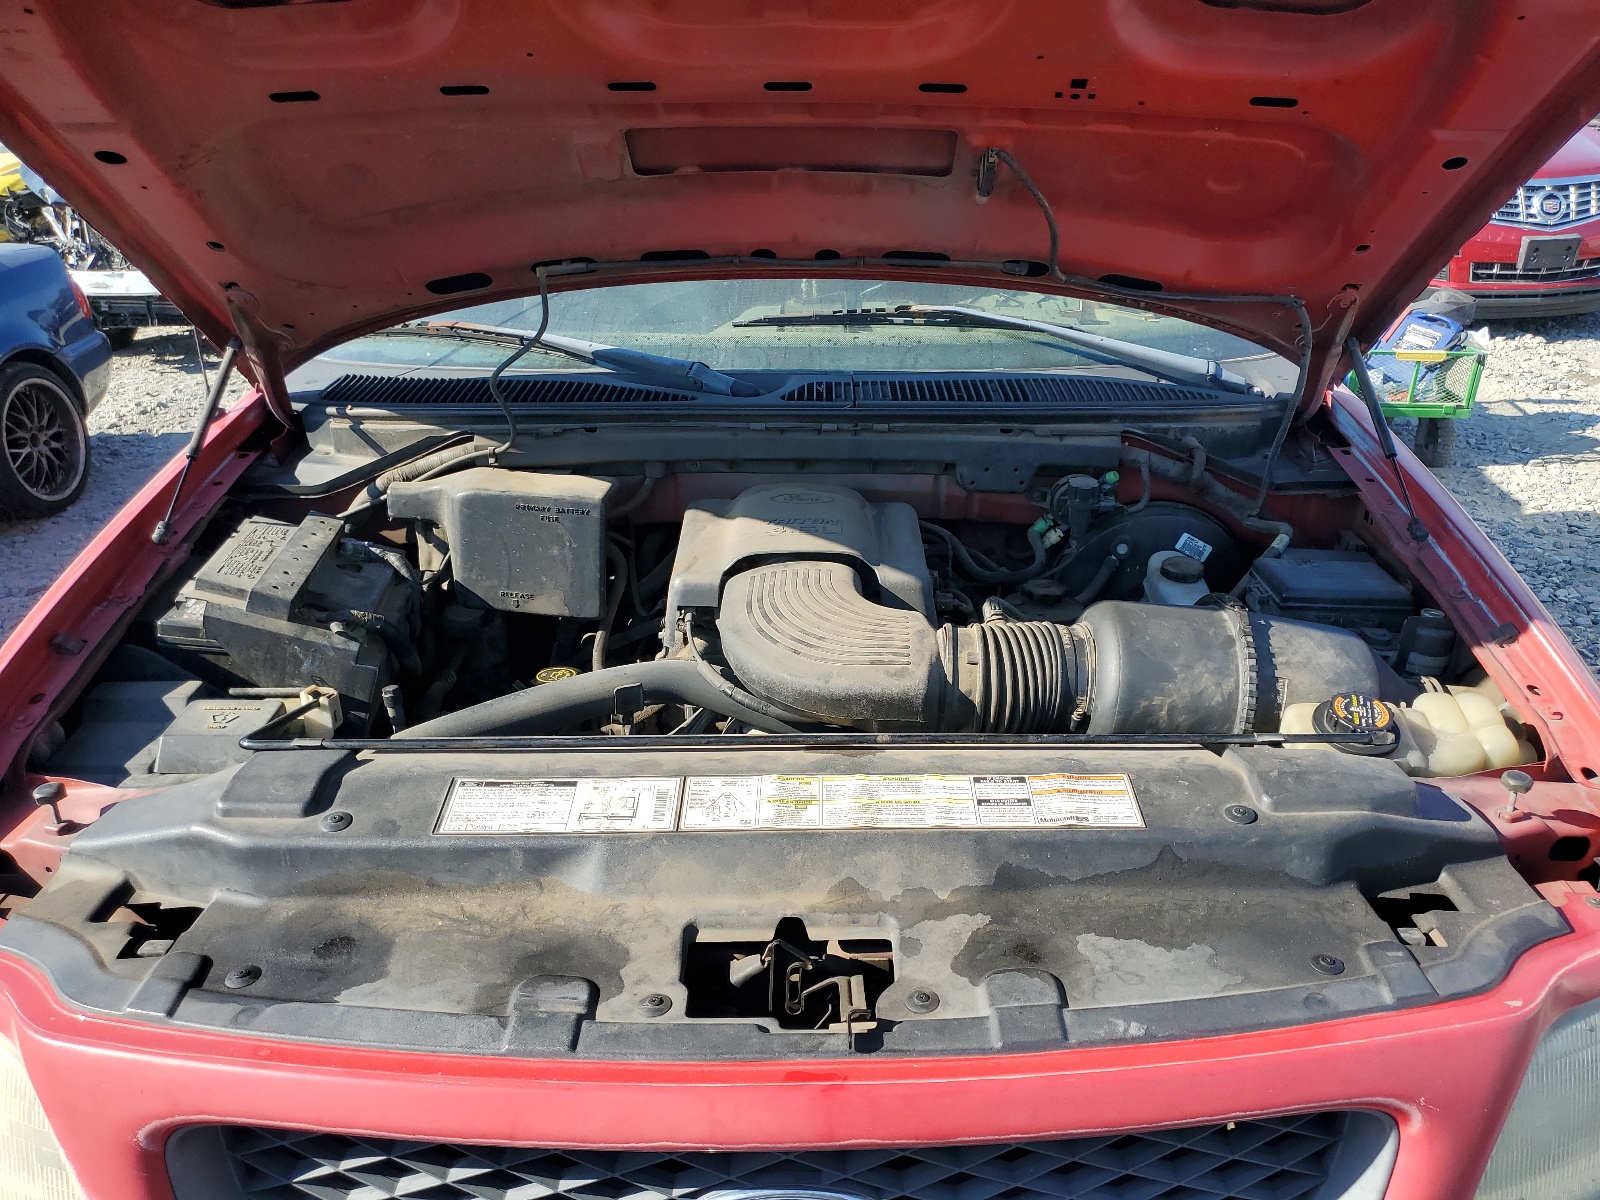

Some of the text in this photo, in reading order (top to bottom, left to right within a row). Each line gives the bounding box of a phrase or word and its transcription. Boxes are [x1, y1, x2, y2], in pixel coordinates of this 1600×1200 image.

[555, 507, 591, 516] BATTERY
[500, 591, 535, 600] RELEASE
[1039, 815, 1076, 823] Motorcraft
